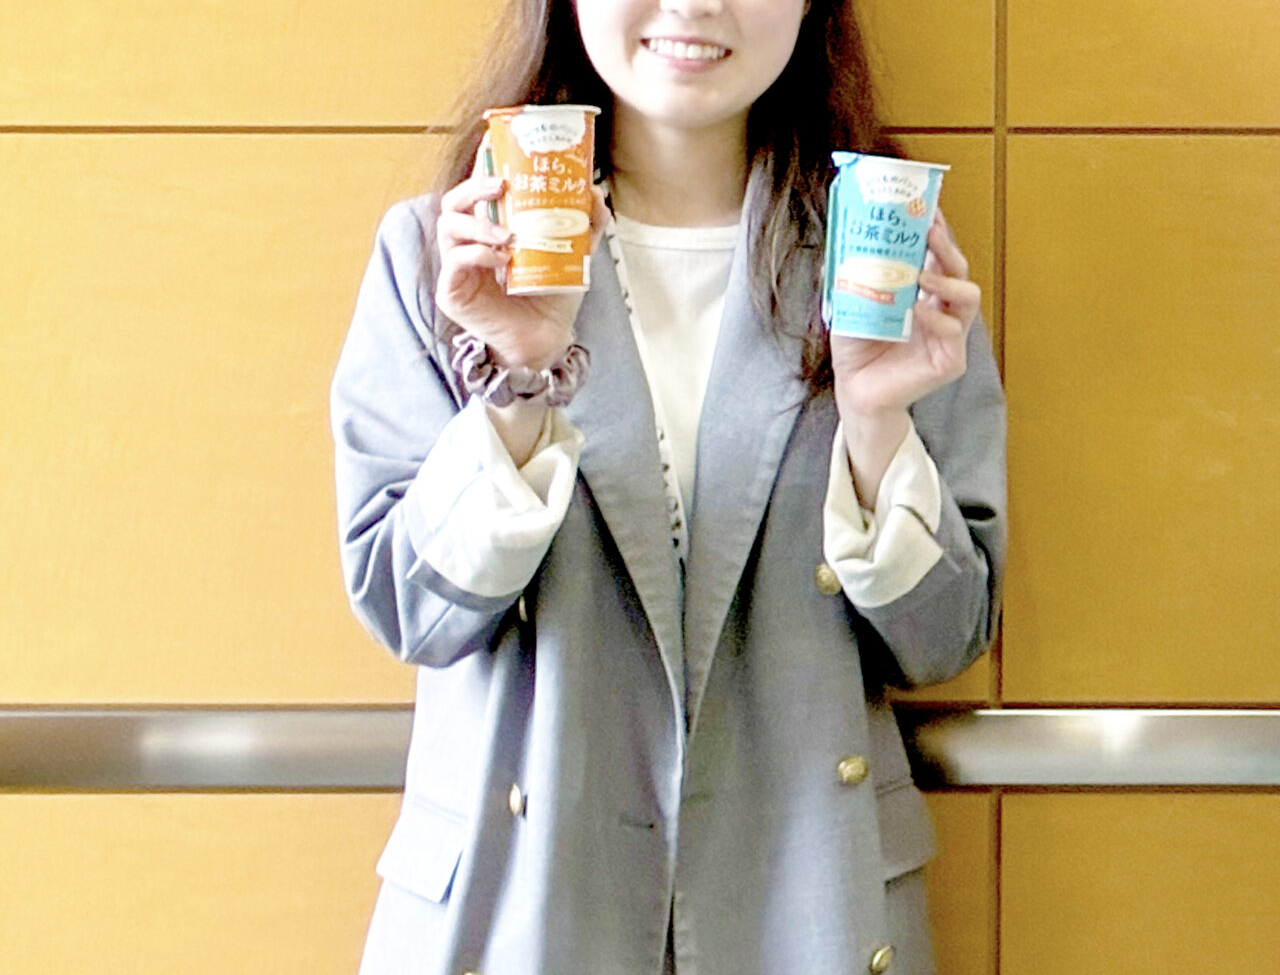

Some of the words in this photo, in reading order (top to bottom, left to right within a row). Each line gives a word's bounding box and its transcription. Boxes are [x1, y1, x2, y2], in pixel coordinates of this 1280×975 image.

[533, 156, 573, 174] ほら、
[513, 176, 587, 194] お茶ミルク
[869, 206, 907, 228] ほら、
[849, 218, 920, 248] お茶ミルク
